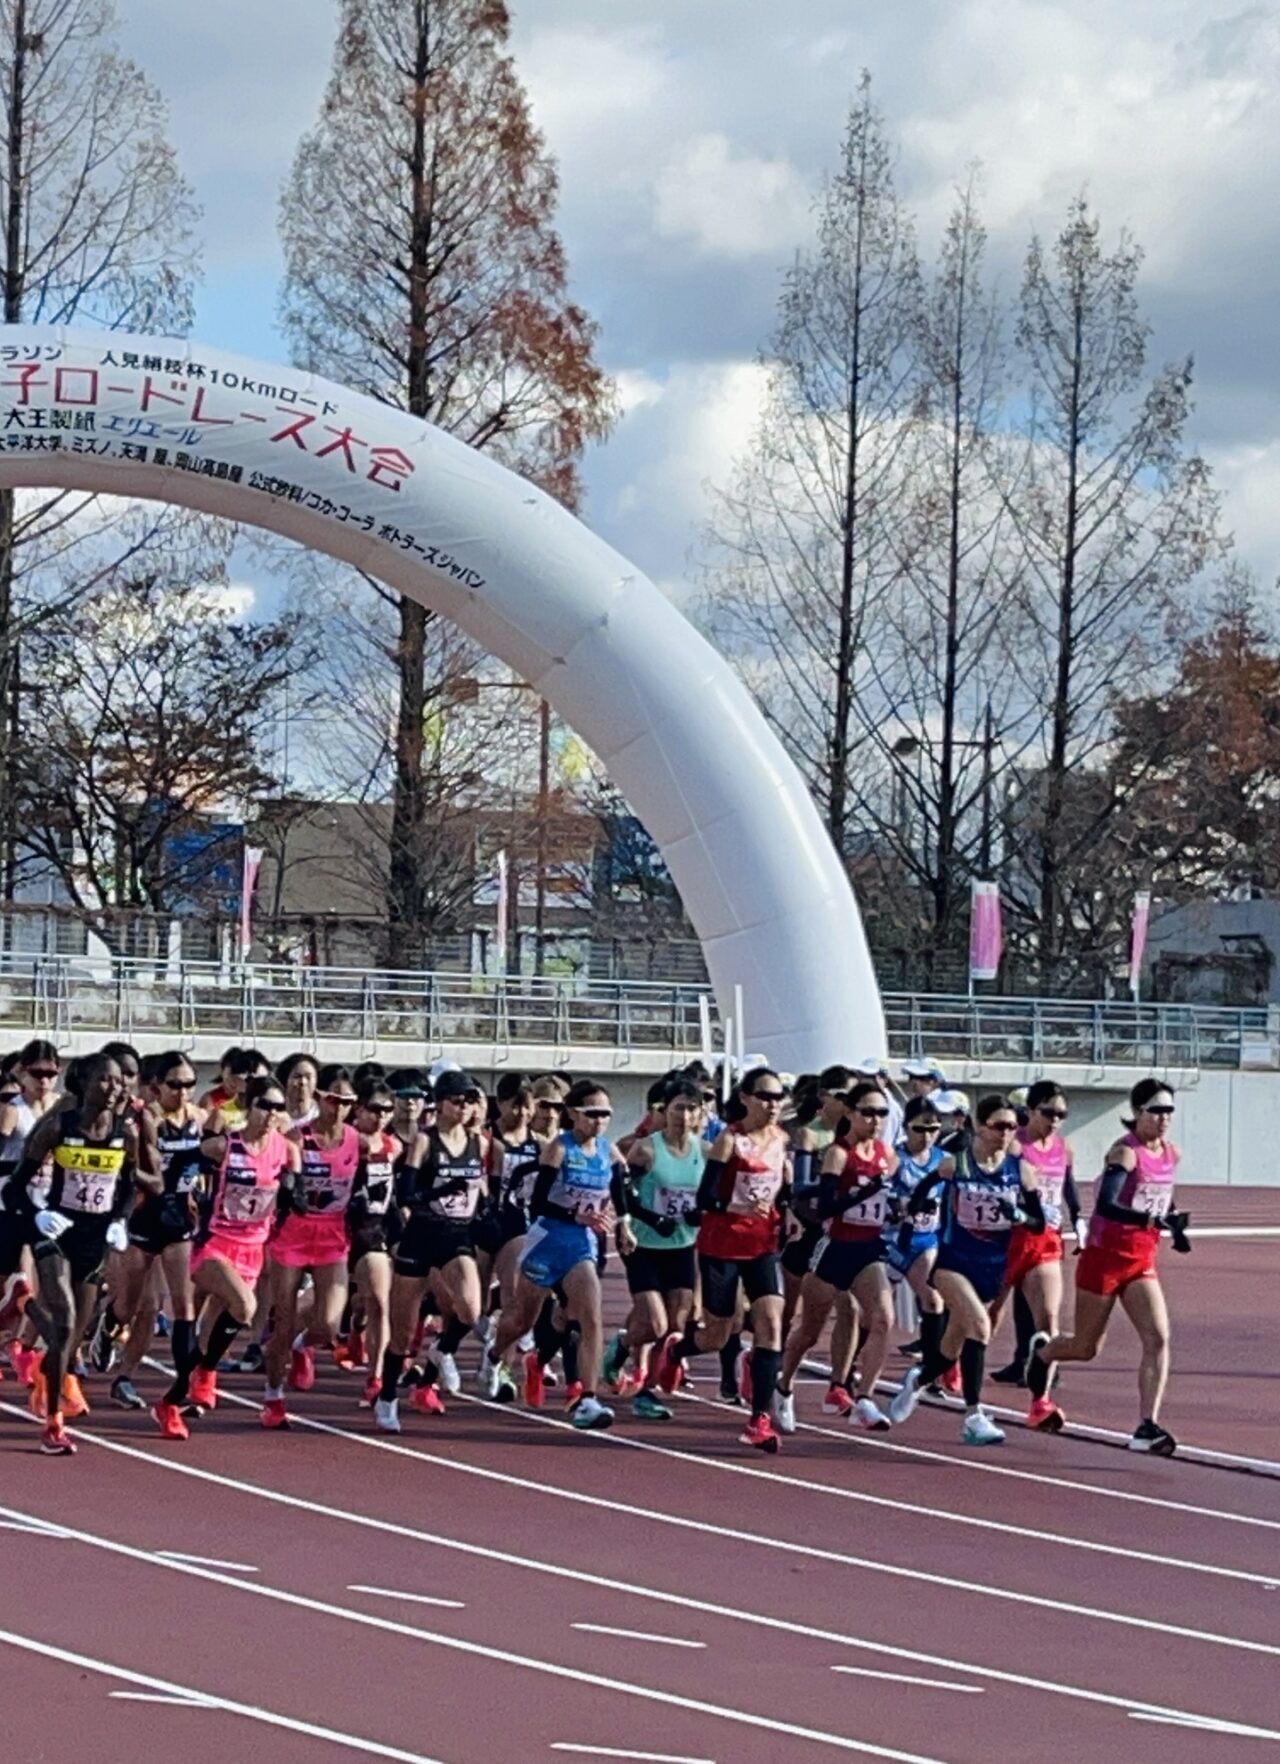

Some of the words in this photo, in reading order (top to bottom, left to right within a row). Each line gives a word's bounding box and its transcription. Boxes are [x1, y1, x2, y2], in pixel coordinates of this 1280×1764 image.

[100, 351, 340, 415] 人見絹枝杯10kmロード
[75, 1186, 105, 1206] 46
[860, 1202, 881, 1219] 11
[974, 1205, 1000, 1222] 13
